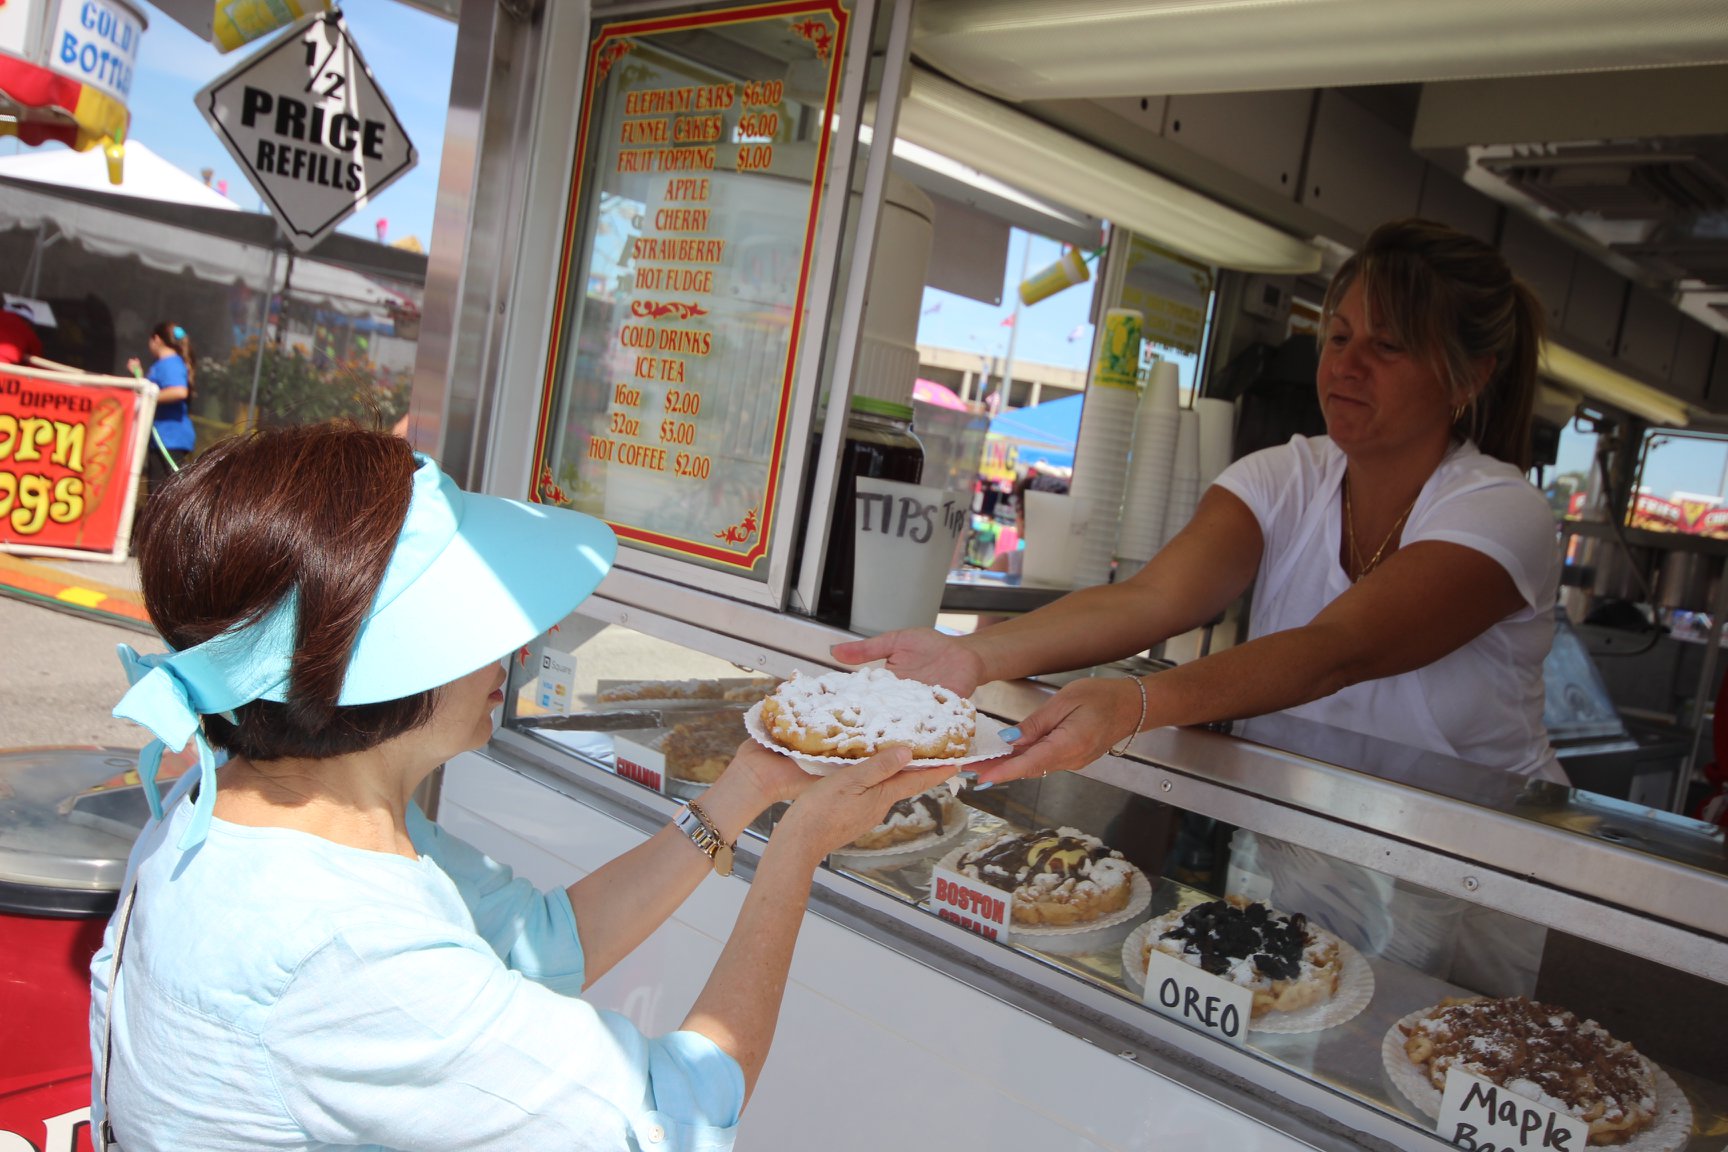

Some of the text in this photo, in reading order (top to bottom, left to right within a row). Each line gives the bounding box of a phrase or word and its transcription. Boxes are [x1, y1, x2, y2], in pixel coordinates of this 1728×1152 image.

[302, 40, 346, 100] 1/2
[624, 79, 783, 115] ELEPHANT EARS $6.00
[241, 86, 386, 161] PRICE
[621, 112, 779, 144] FUNNEL CAKES $6.00
[256, 138, 363, 192] REFILLS
[617, 145, 773, 173] FRUIT TOPPING $1.00
[664, 178, 709, 201] APPLE
[655, 208, 711, 232] CHERRY
[632, 238, 725, 263] STRAWBERRY
[635, 267, 712, 293] HOT FUDGE
[621, 325, 711, 356] COLD DRINKS
[634, 356, 685, 383] ICE TEA
[20, 389, 93, 412] DIPPED
[614, 384, 701, 416] 16oz $2.00
[610, 413, 695, 446] 32oz $3.00
[589, 438, 711, 480] HOT COFFEE $2.00
[856, 491, 938, 544] TIPS
[935, 876, 1006, 925] BOSTON
[1160, 977, 1240, 1038] OREO
[1459, 1082, 1573, 1152] Maple
